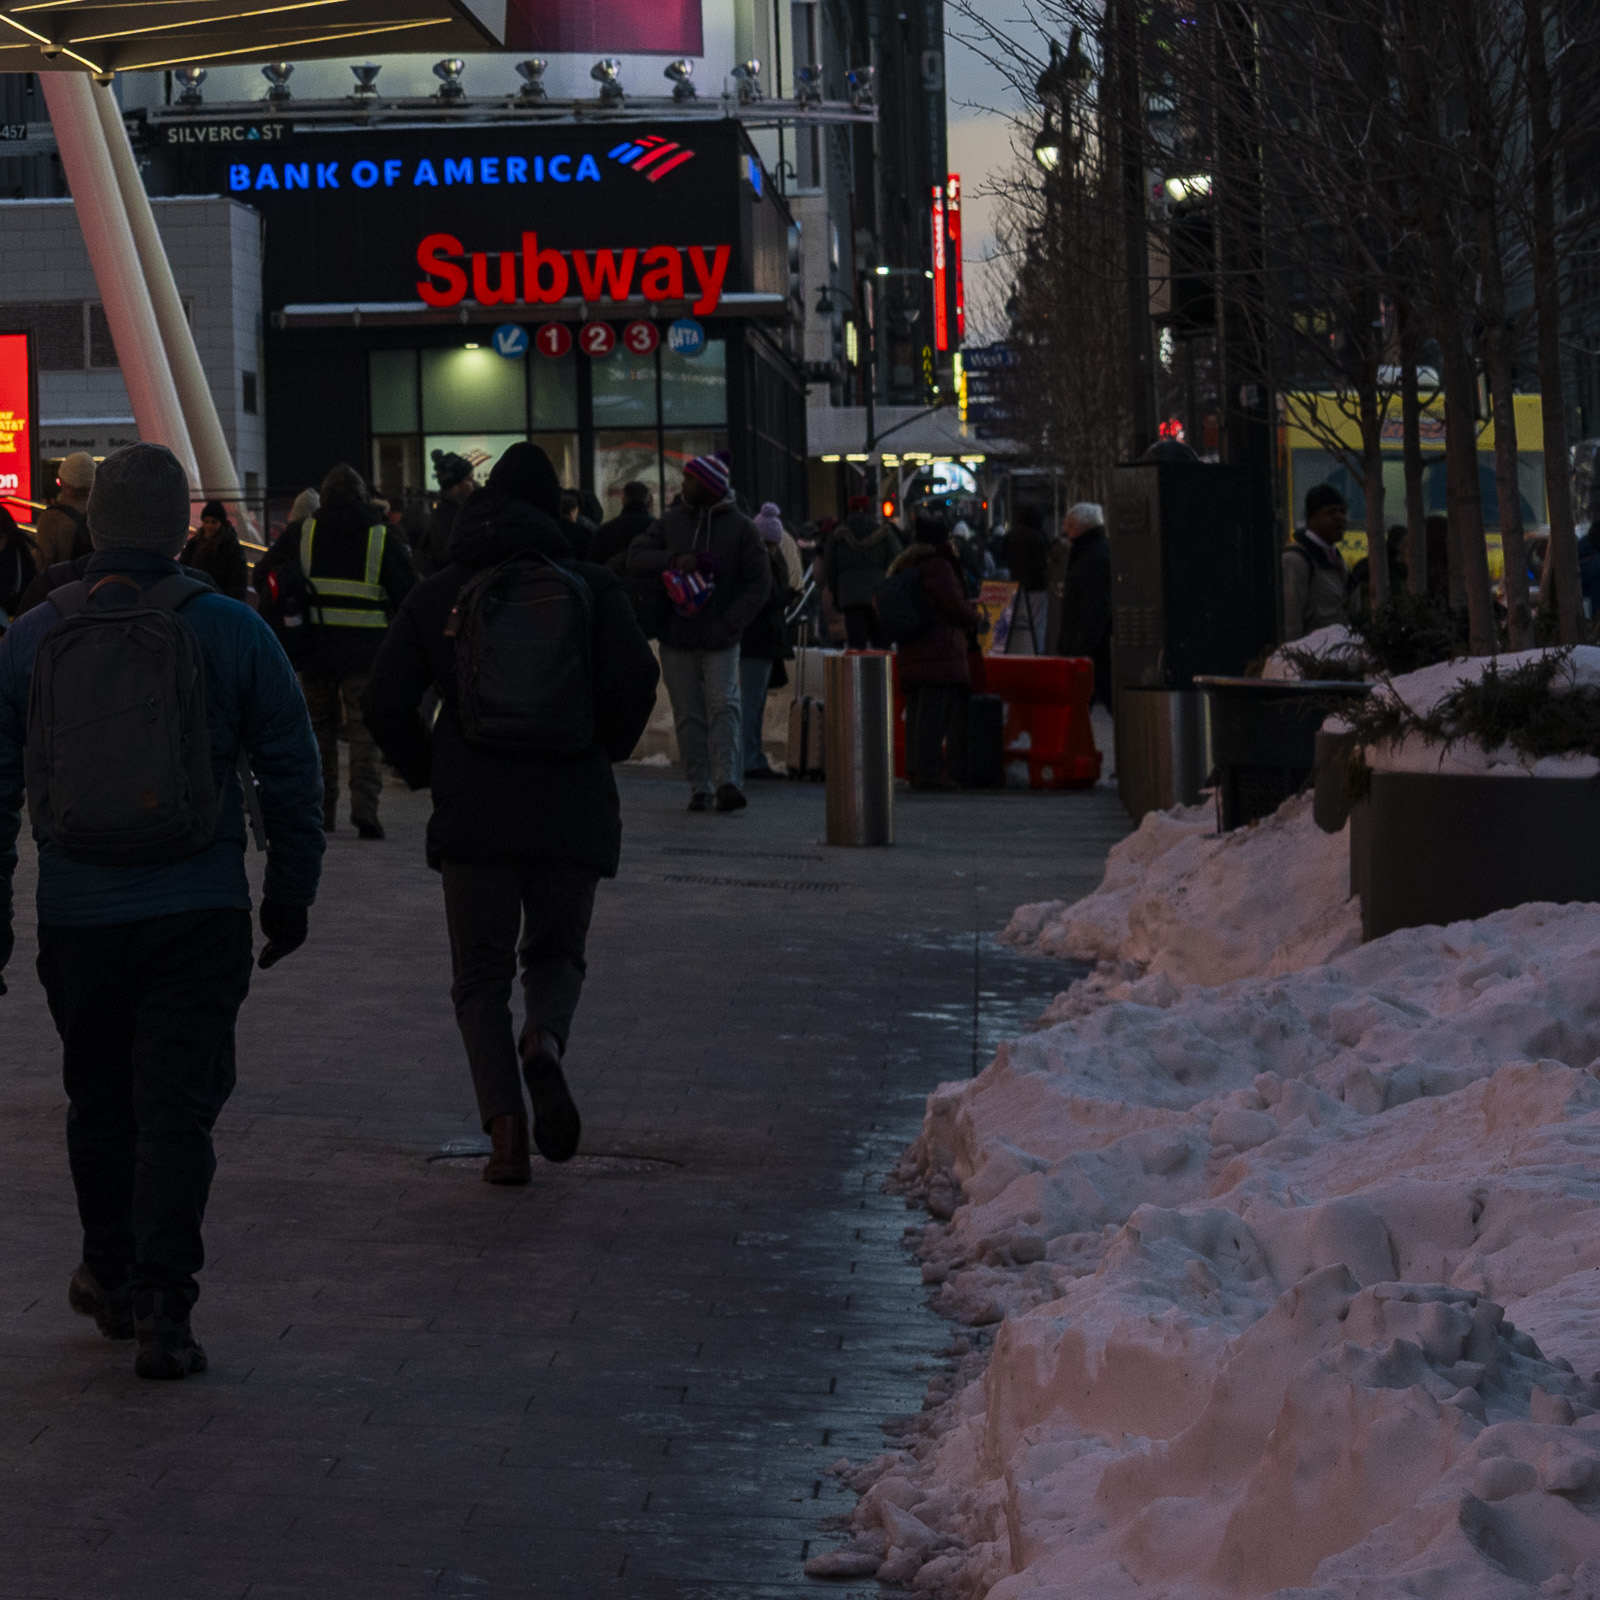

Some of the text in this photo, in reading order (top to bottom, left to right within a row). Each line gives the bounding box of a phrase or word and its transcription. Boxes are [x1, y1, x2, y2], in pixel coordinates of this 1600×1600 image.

[167, 124, 284, 143] SILVERCAST
[229, 154, 602, 191] BANK OF AMERICA
[416, 232, 732, 316] Subway
[545, 325, 700, 353] 1 2 3 MTA
